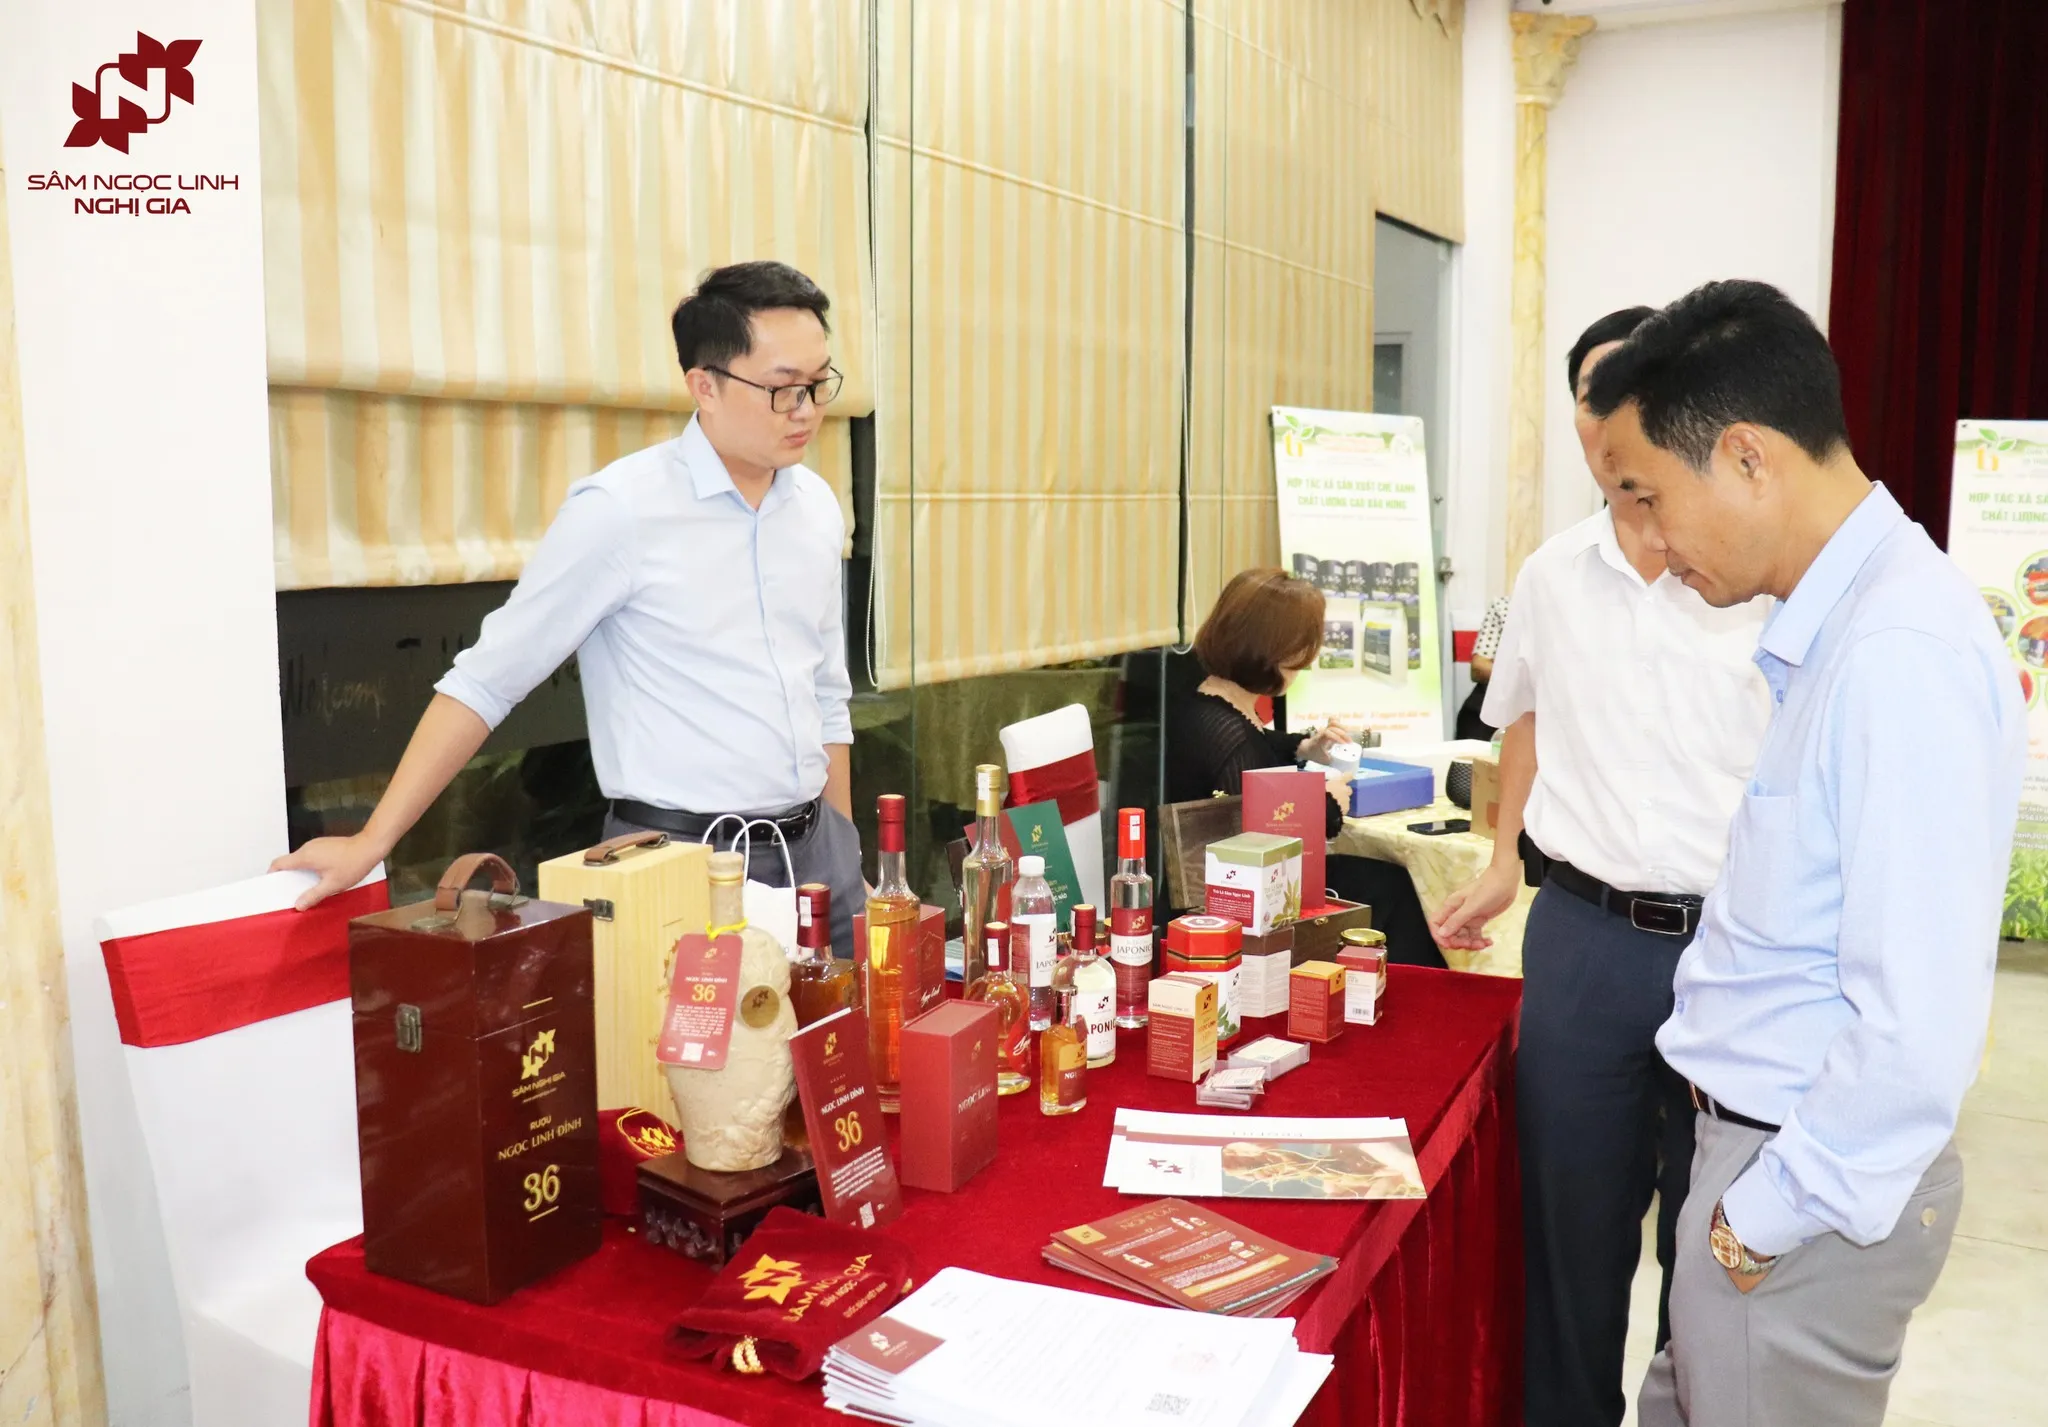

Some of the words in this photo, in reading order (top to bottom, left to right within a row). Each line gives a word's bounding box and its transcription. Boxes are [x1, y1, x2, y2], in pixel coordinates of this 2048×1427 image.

[692, 984, 716, 1002] 36
[821, 1101, 837, 1115] NGỌC
[837, 1093, 850, 1107] LINH
[529, 1114, 552, 1131] RƯỢU
[835, 1110, 862, 1153] 36
[498, 1139, 529, 1160] NGỌC
[531, 1129, 555, 1148] LINH
[523, 1164, 561, 1212] 36
[844, 1254, 873, 1277] GIA
